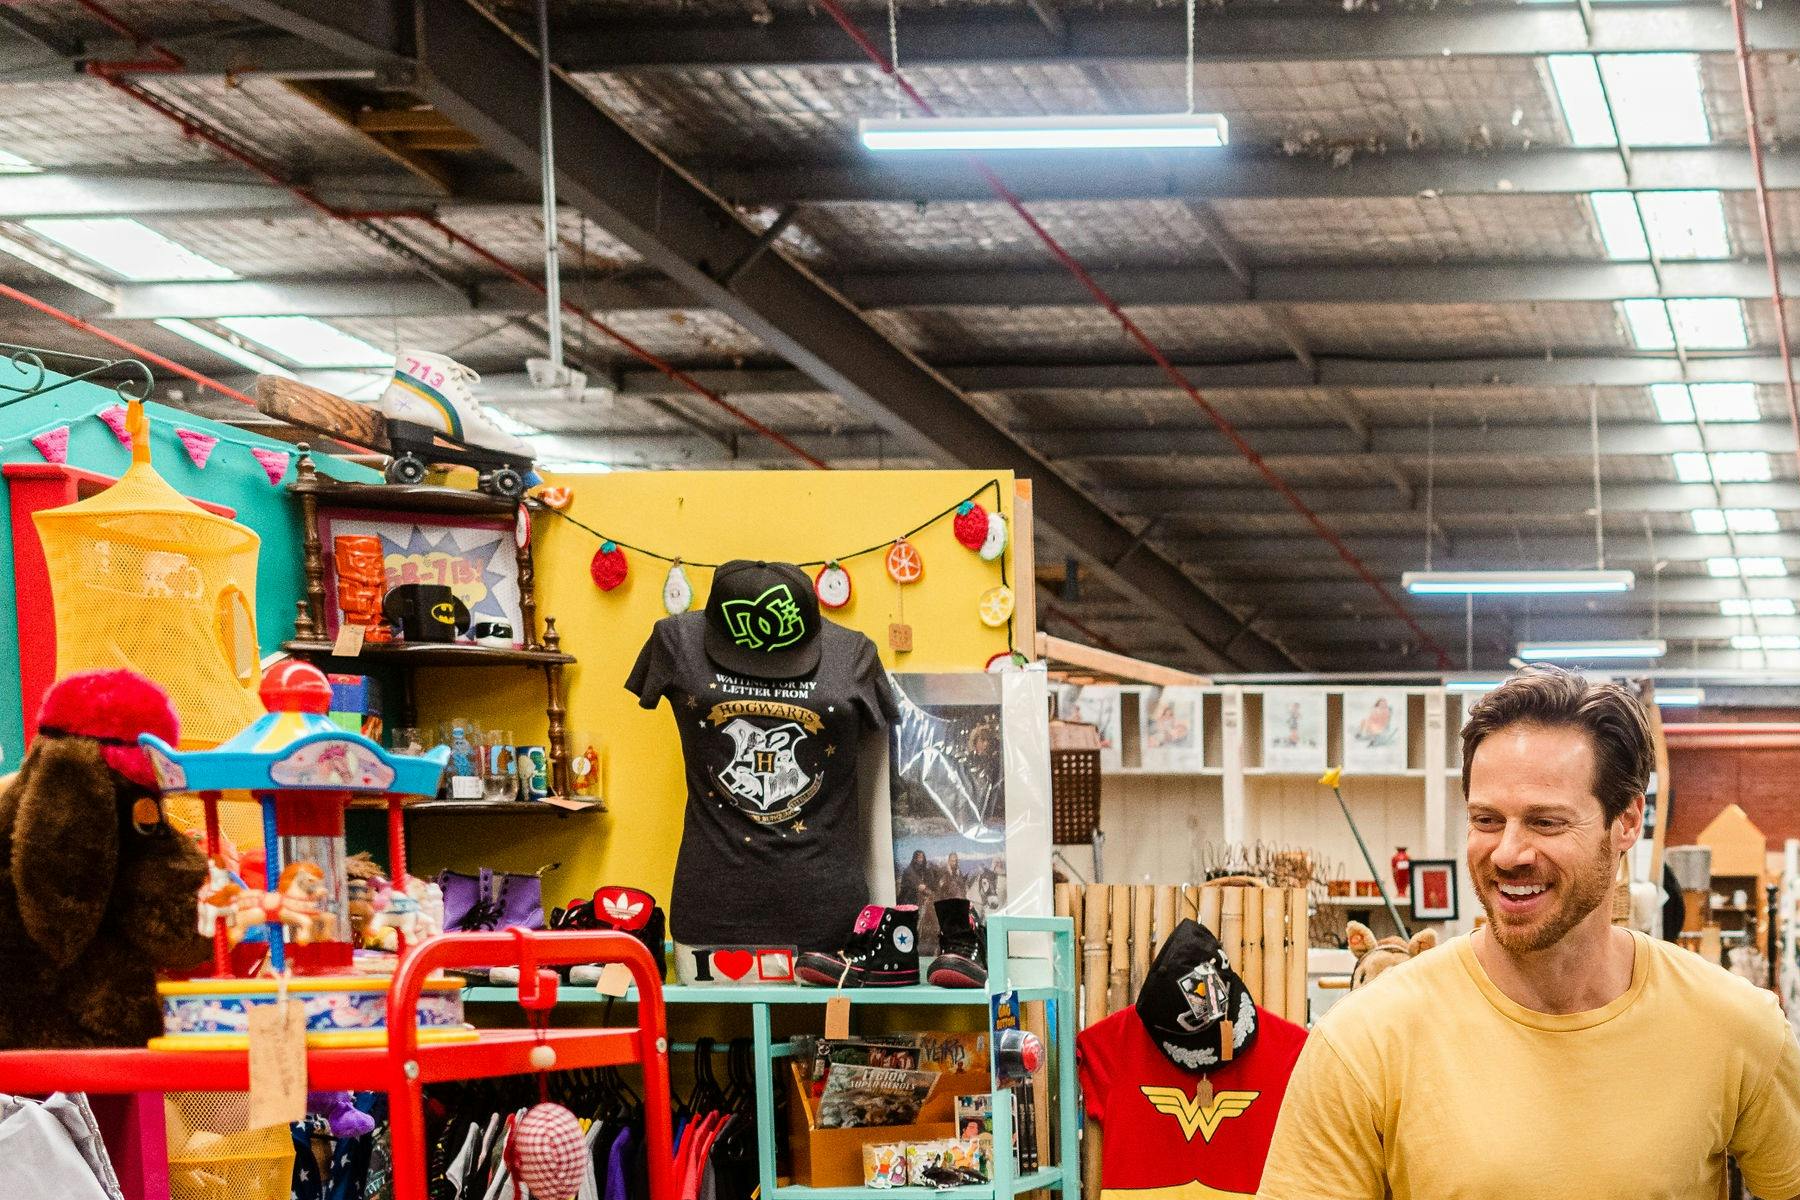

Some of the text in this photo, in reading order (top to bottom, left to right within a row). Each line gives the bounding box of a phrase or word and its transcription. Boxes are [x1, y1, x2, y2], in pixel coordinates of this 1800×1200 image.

[406, 357, 446, 389] 713
[722, 684, 810, 700] LETTER FROM
[799, 681, 819, 691] MY
[718, 701, 816, 723] HOGWARTS
[756, 752, 774, 773] H
